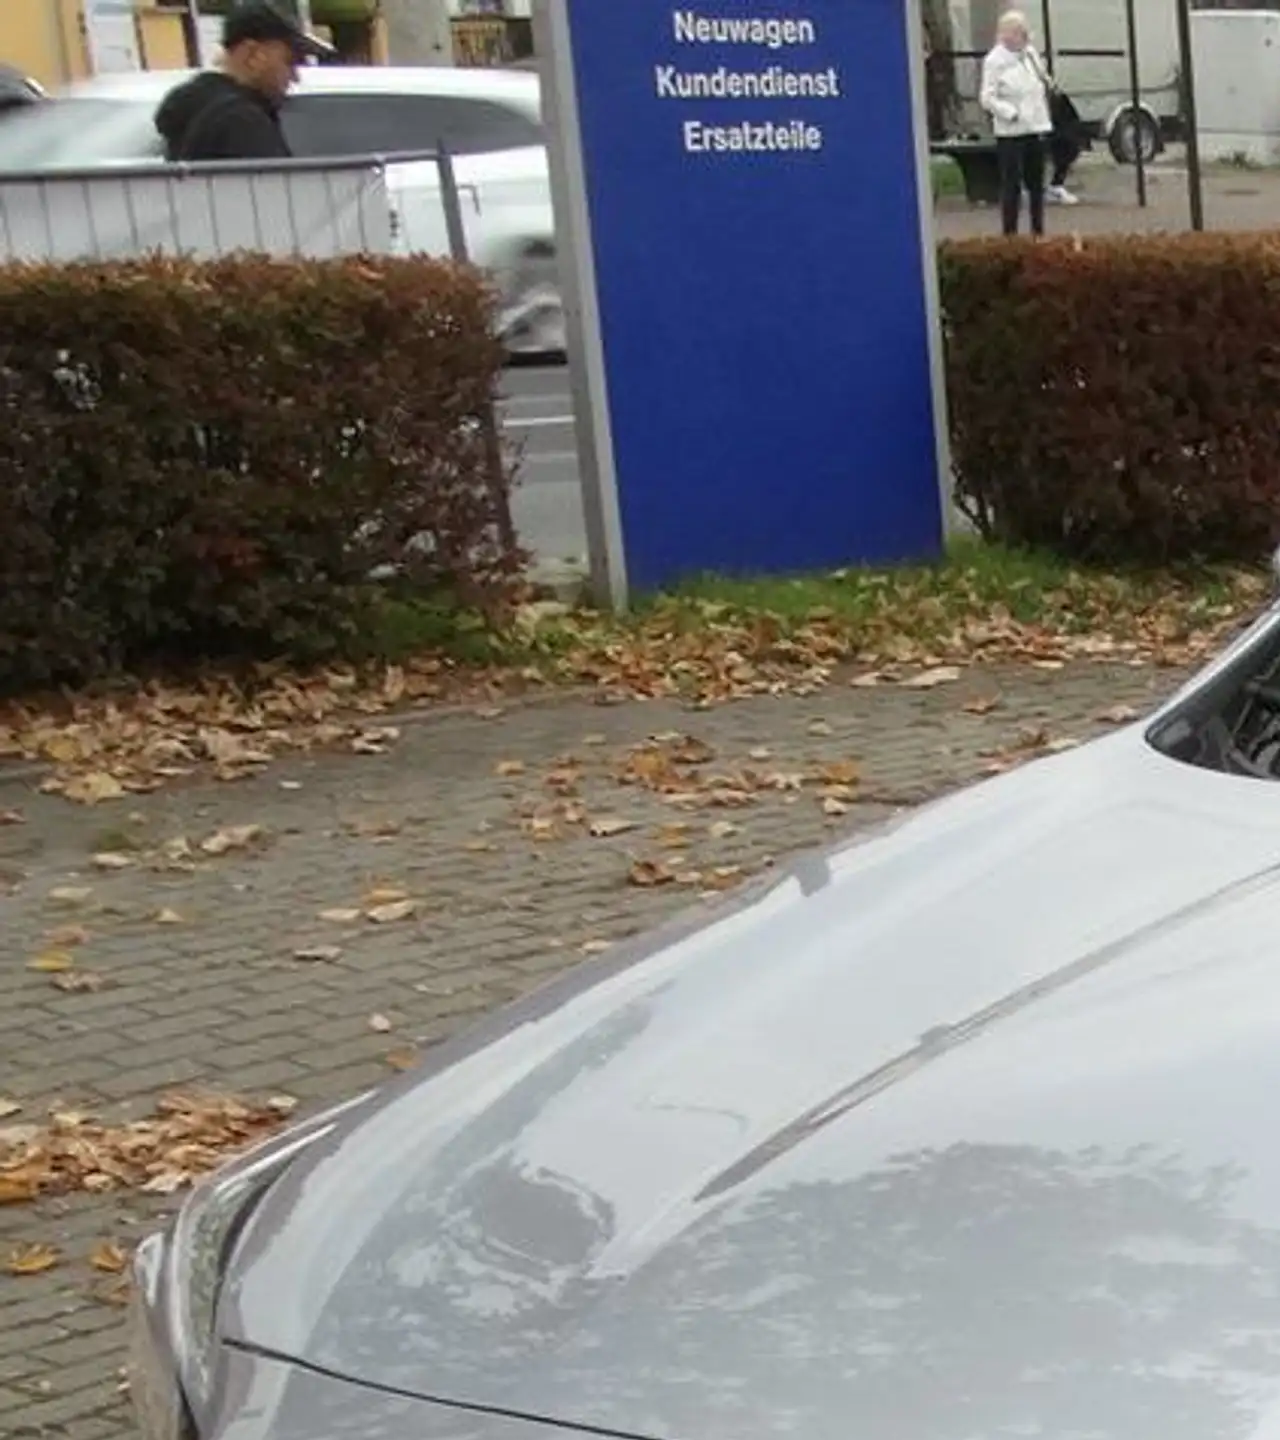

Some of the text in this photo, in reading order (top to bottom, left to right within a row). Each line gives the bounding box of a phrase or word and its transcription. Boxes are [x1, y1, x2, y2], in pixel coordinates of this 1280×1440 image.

[673, 11, 816, 49] Neuwagen
[655, 64, 841, 98] Kundendienst
[683, 120, 823, 152] Ersatzteile
